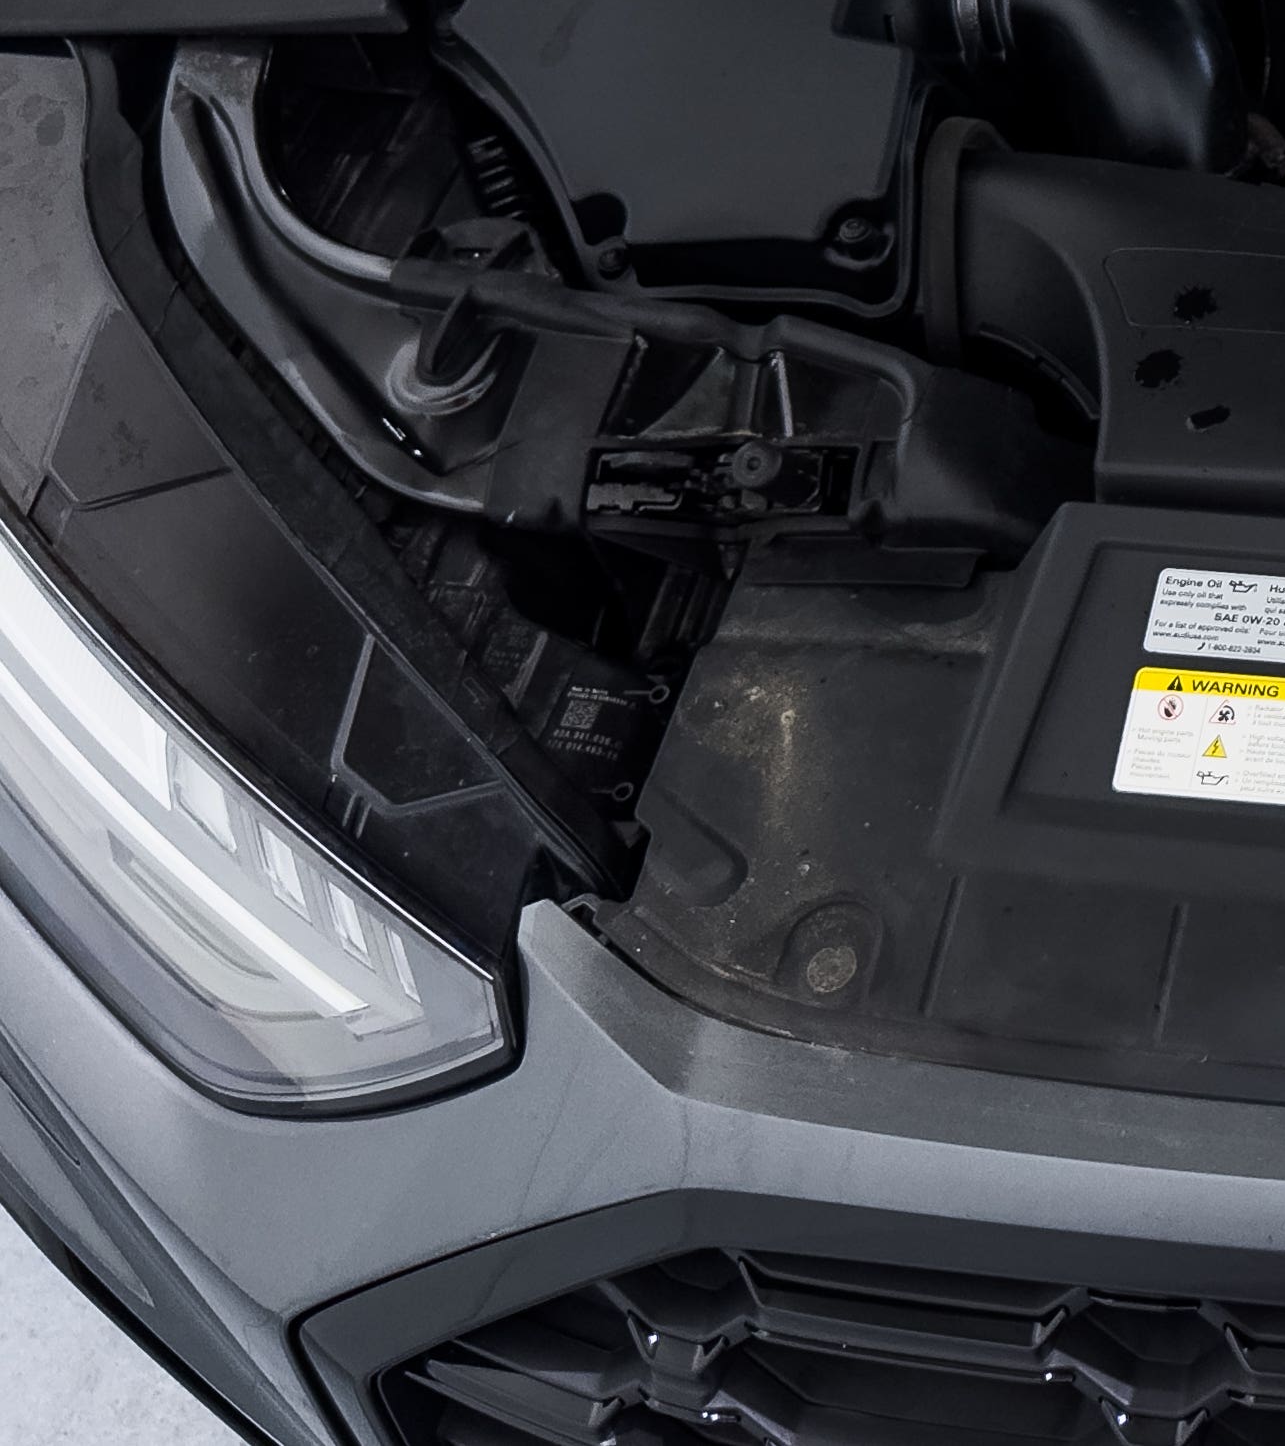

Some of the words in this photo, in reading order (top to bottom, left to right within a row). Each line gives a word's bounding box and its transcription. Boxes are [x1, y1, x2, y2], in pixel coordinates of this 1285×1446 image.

[1166, 576, 1203, 587] Engine
[1207, 579, 1223, 588] Oil
[1162, 588, 1176, 596] Use
[1178, 589, 1194, 598] only
[1197, 590, 1206, 598] oil
[1214, 612, 1239, 623] SAE
[1192, 680, 1280, 697] WARNING
